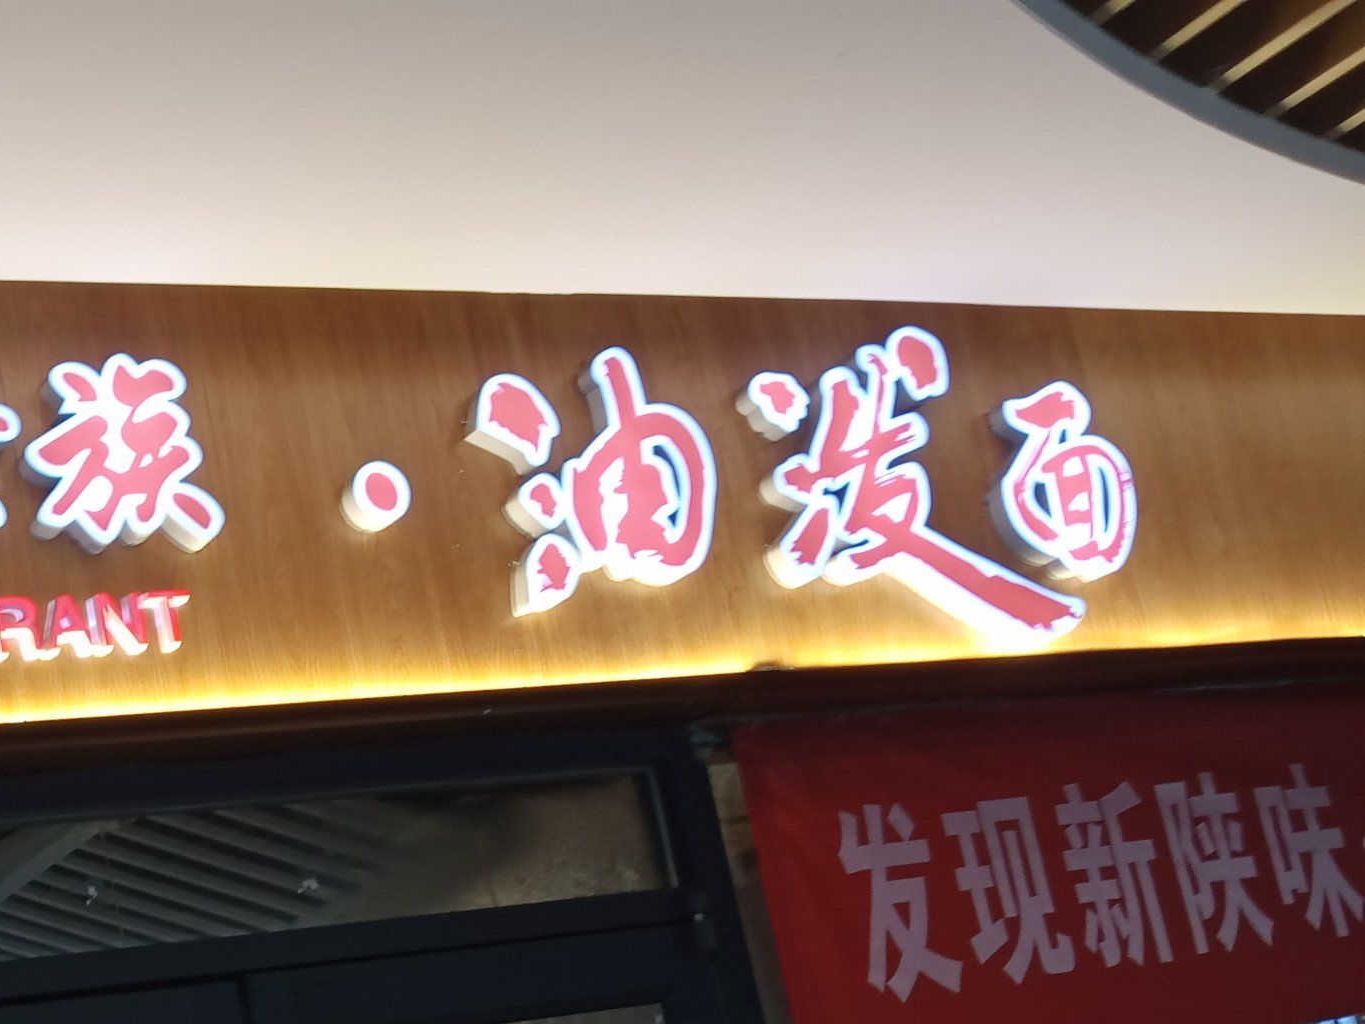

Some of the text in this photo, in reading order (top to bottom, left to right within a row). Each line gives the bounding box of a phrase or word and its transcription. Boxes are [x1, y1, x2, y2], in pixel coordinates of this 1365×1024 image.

[838, 763, 1363, 1002] 发现新陕味
